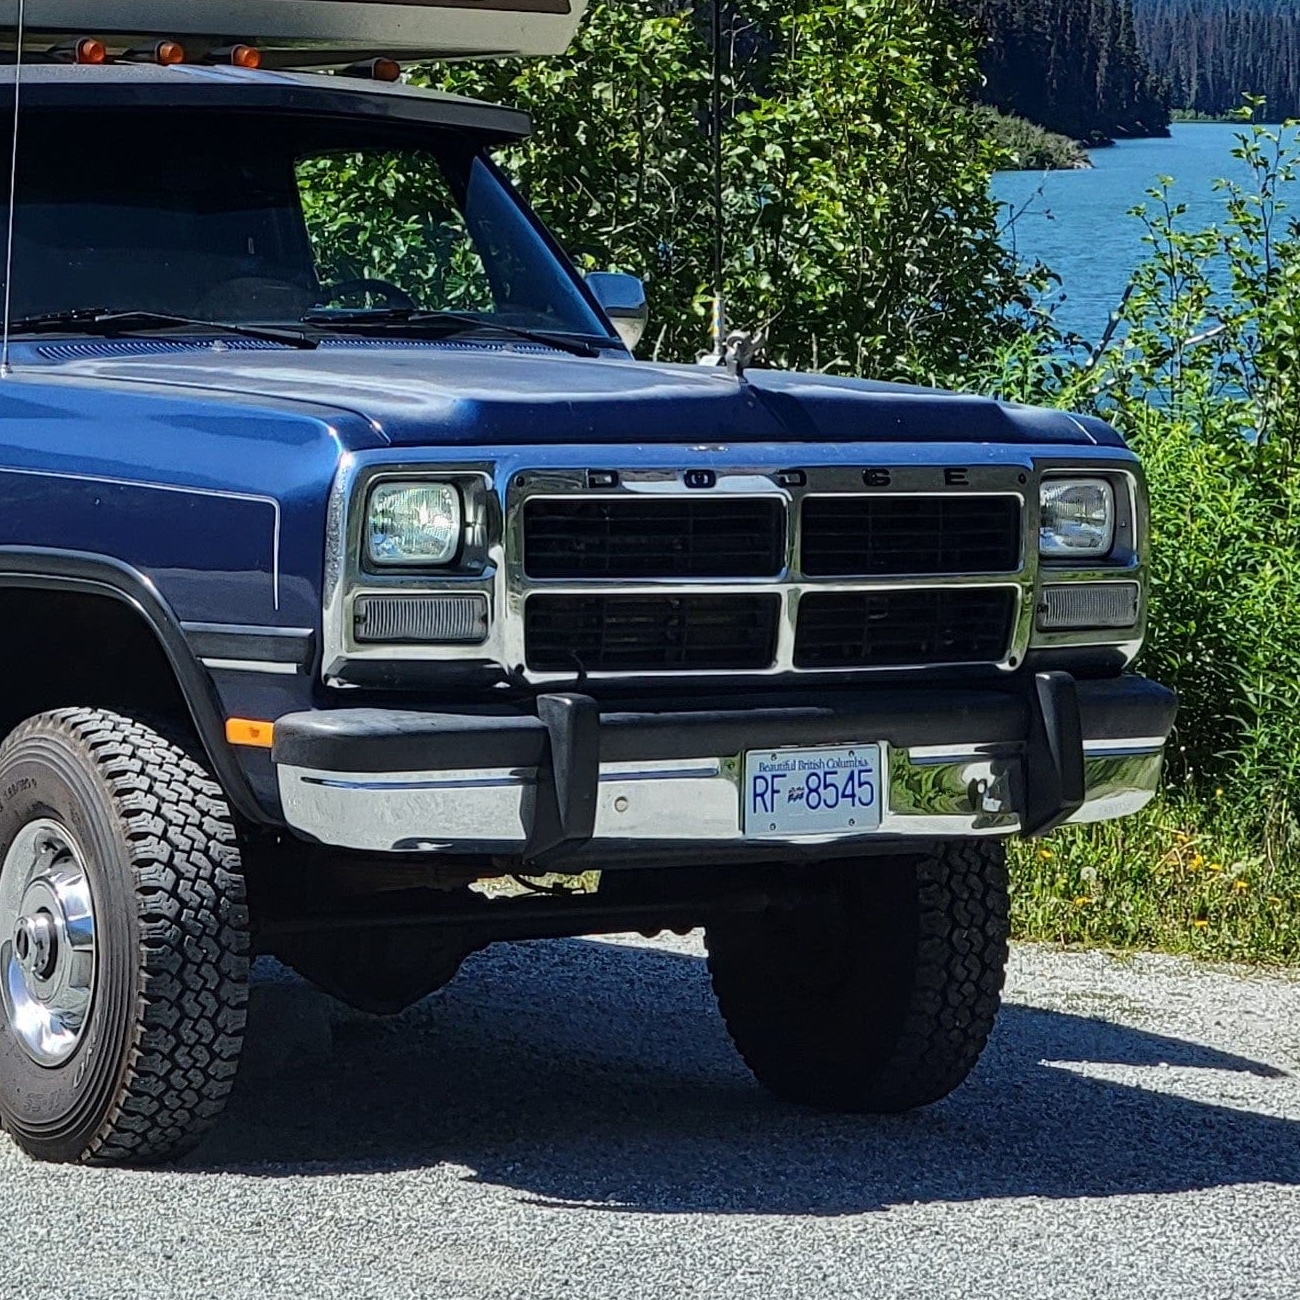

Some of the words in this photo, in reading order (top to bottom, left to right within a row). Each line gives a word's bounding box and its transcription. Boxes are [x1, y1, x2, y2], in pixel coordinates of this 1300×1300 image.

[587, 468, 969, 488] DODGE
[759, 760, 796, 772] Beautiful
[798, 759, 825, 770] British
[826, 757, 868, 769] Columbia
[753, 774, 787, 814] RF
[805, 769, 874, 810] 8545
